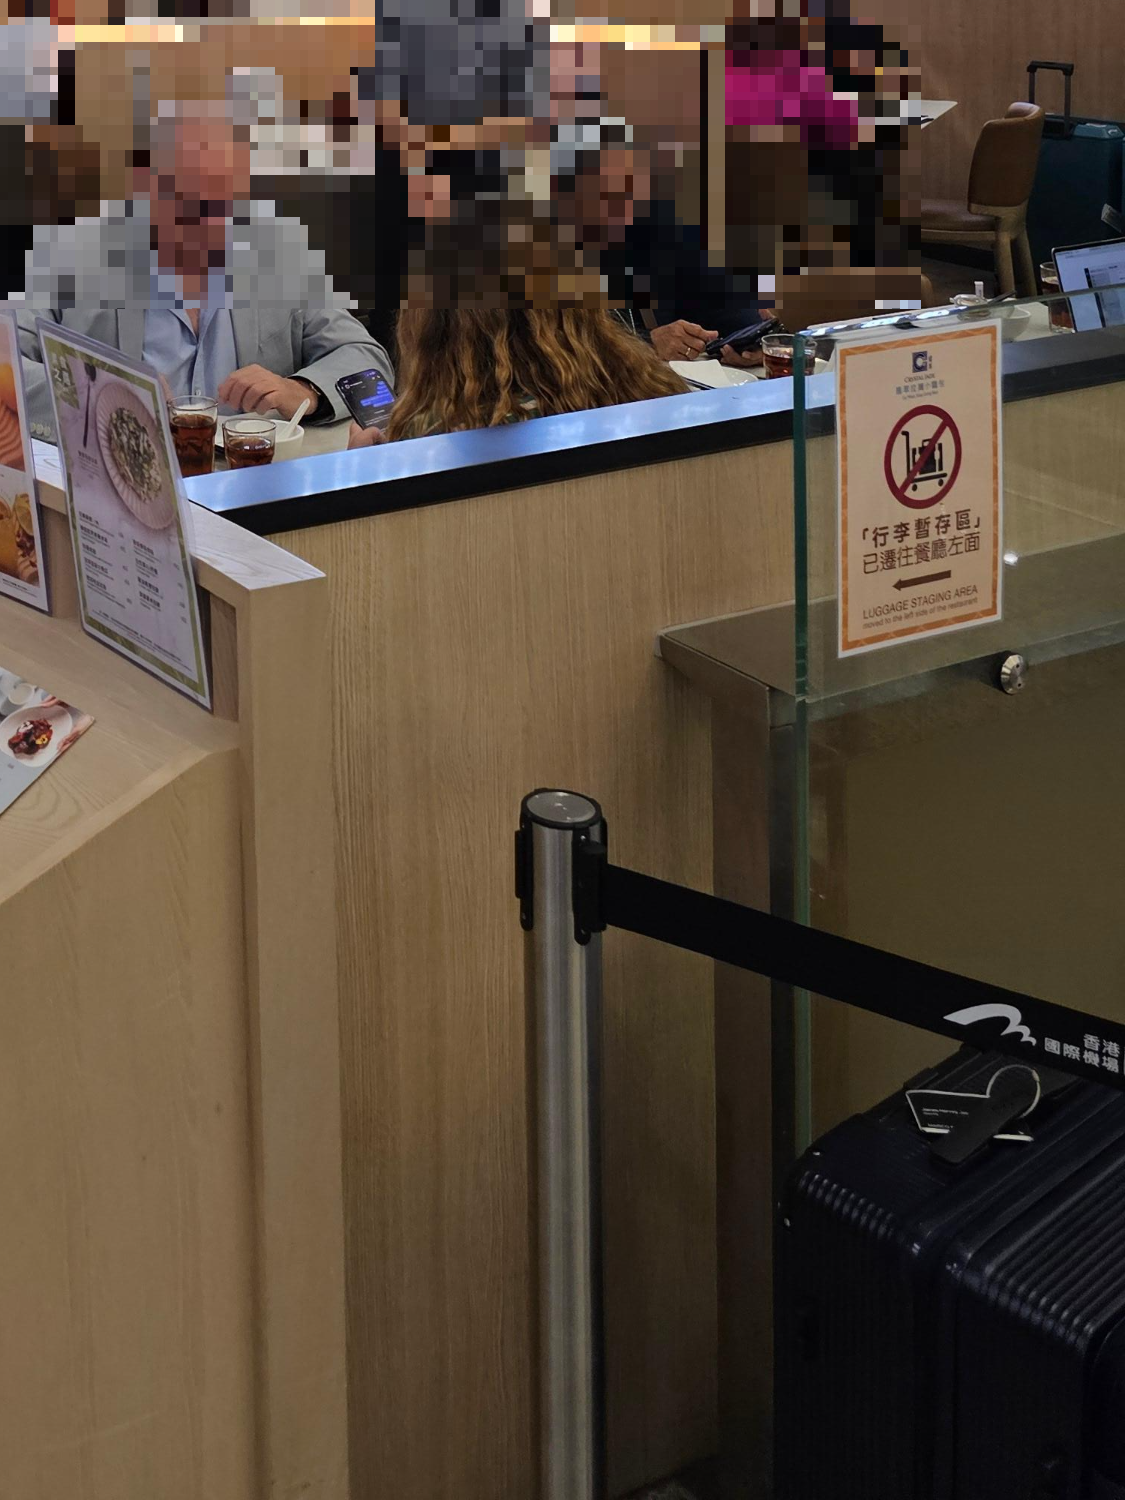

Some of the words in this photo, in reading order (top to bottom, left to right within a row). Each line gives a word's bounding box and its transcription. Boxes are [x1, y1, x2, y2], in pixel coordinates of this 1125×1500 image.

[863, 531, 980, 574] 已遷往餐廳左面
[863, 600, 909, 619] LUGGAGE
[911, 590, 951, 609] STAGING
[954, 585, 979, 598] AREA
[863, 619, 884, 629] moved
[892, 614, 903, 623] the
[1044, 1037, 1120, 1074] 國際機場
[1083, 1033, 1121, 1058] 香港
